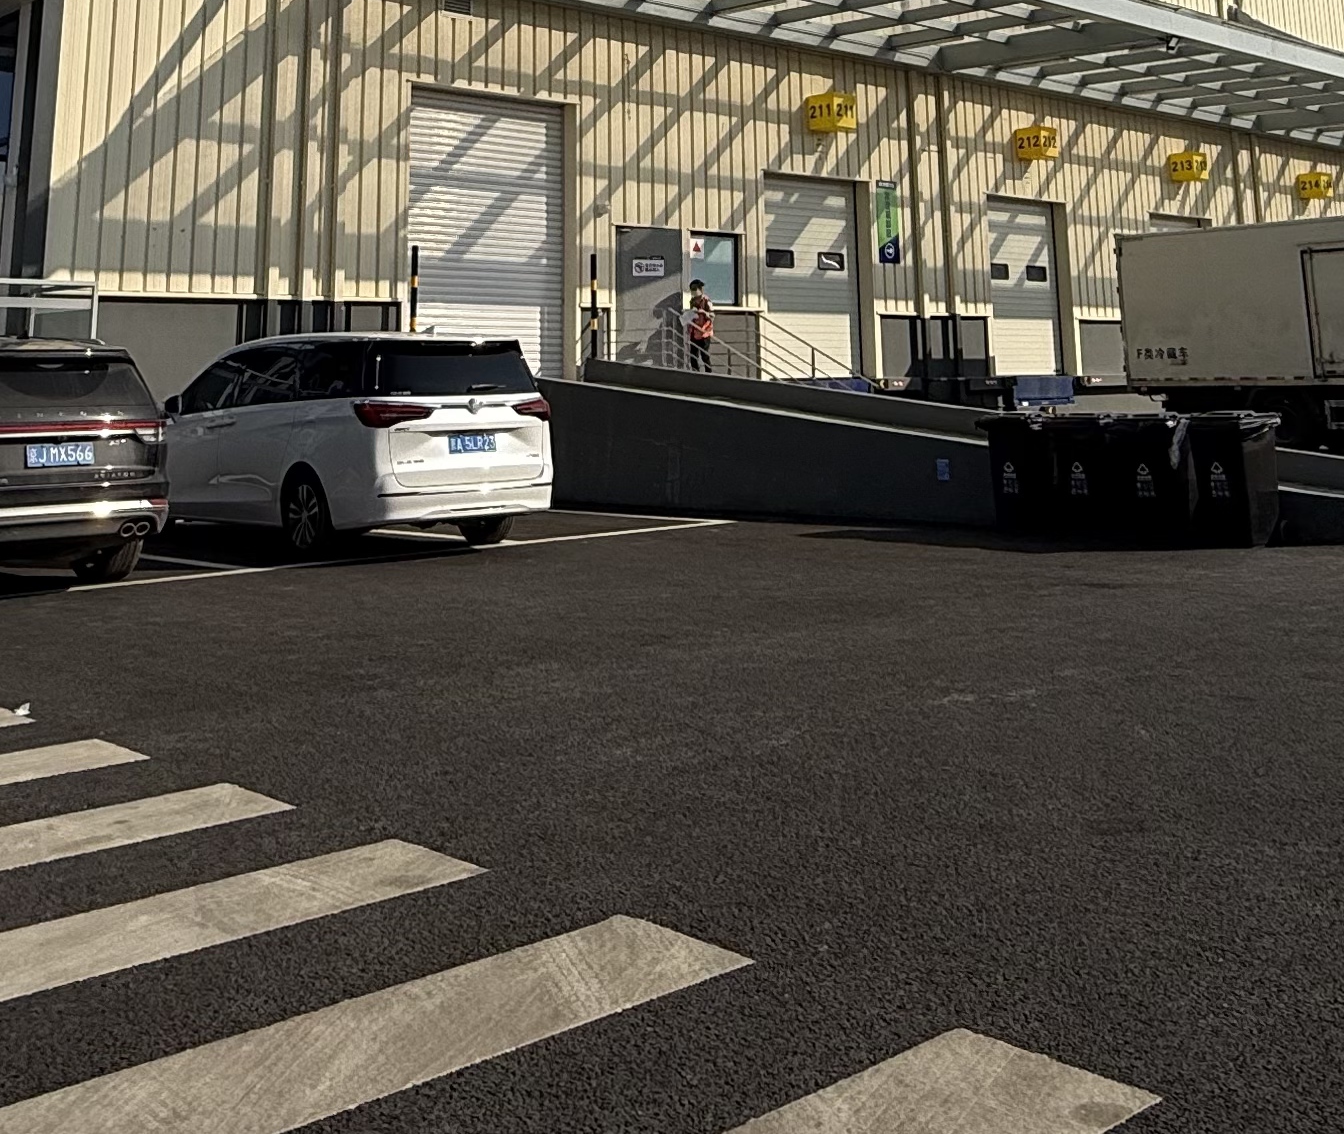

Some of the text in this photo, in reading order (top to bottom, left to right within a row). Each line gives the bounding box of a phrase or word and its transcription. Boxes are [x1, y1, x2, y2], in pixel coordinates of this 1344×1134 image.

[809, 103, 831, 119] 211
[836, 103, 854, 119] 211
[1018, 135, 1040, 150] 212
[1043, 135, 1057, 149] 212
[1172, 159, 1193, 172] 213
[1300, 179, 1321, 191] 214
